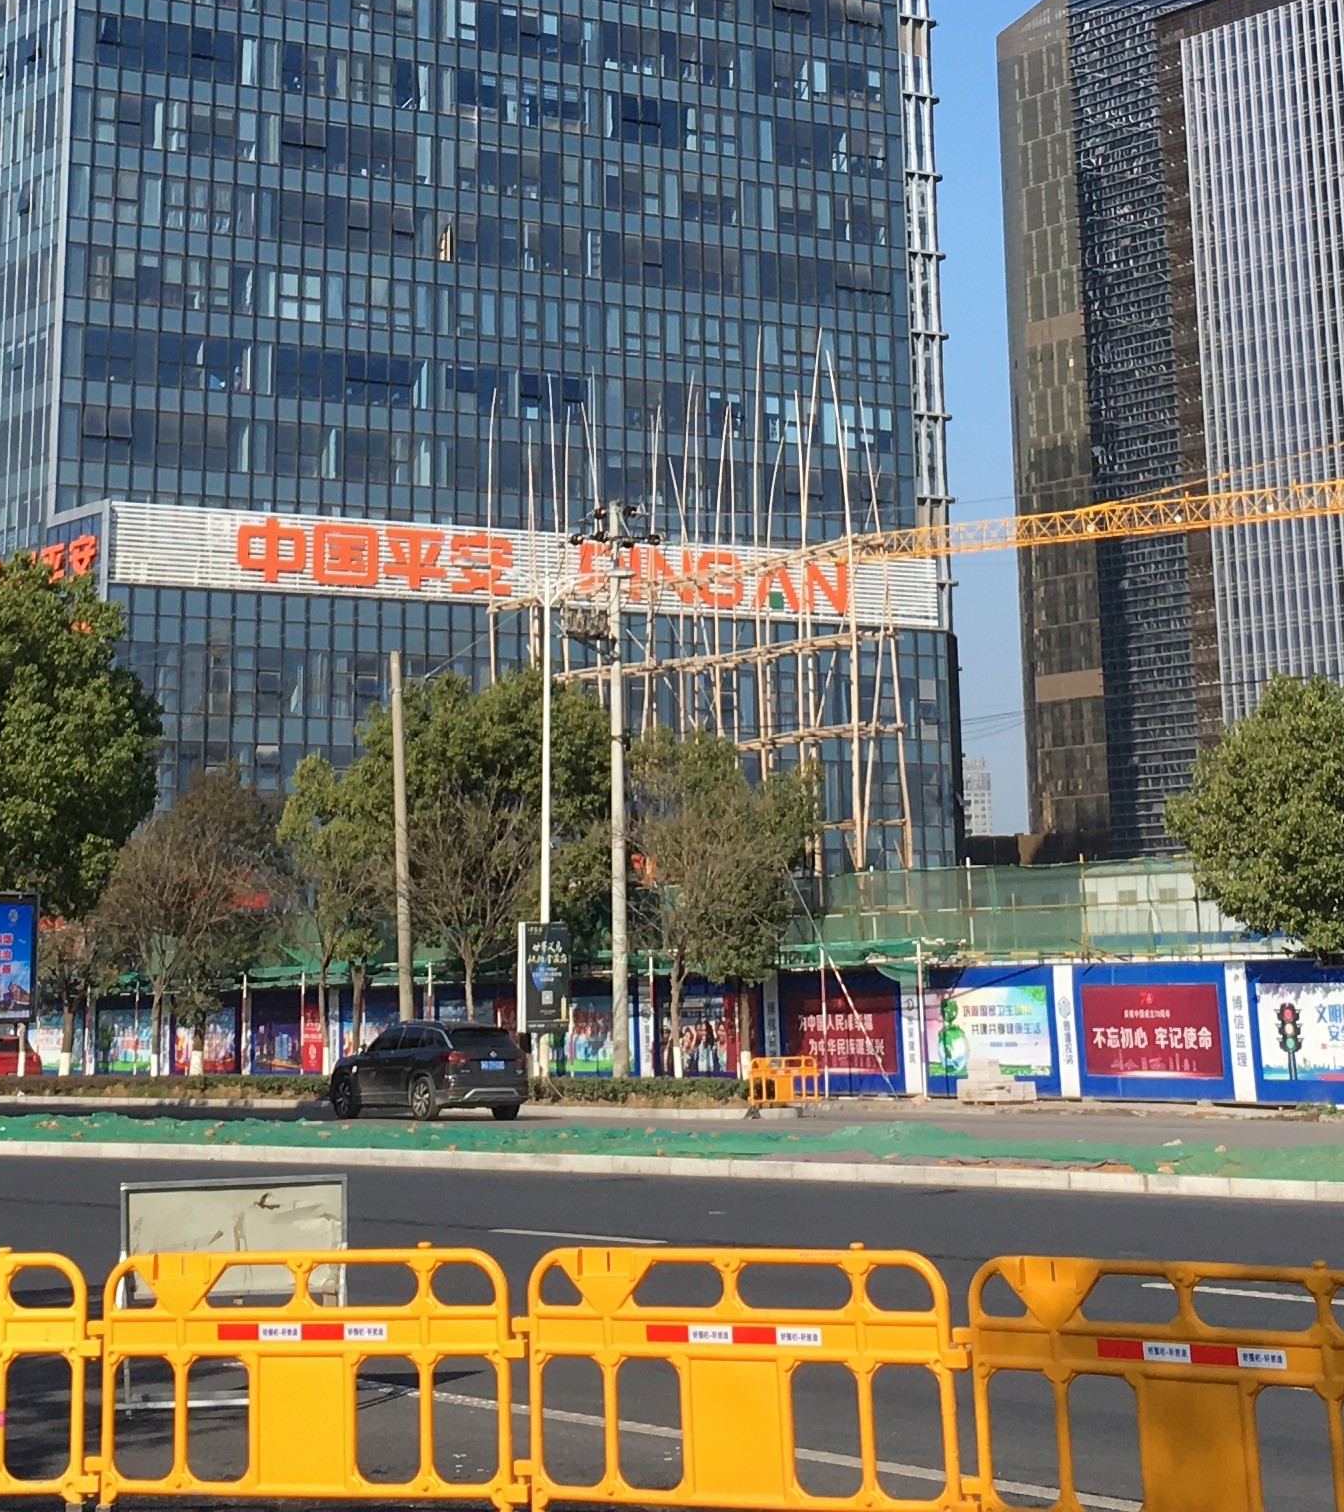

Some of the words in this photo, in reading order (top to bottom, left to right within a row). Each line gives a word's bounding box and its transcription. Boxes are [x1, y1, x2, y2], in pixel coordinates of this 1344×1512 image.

[30, 533, 98, 584] 平安
[236, 516, 513, 595] 中国平安
[1092, 1026, 1149, 1049] 不忘初心
[1155, 1026, 1213, 1050] 牢记使命
[1232, 995, 1248, 1068] 博信监理
